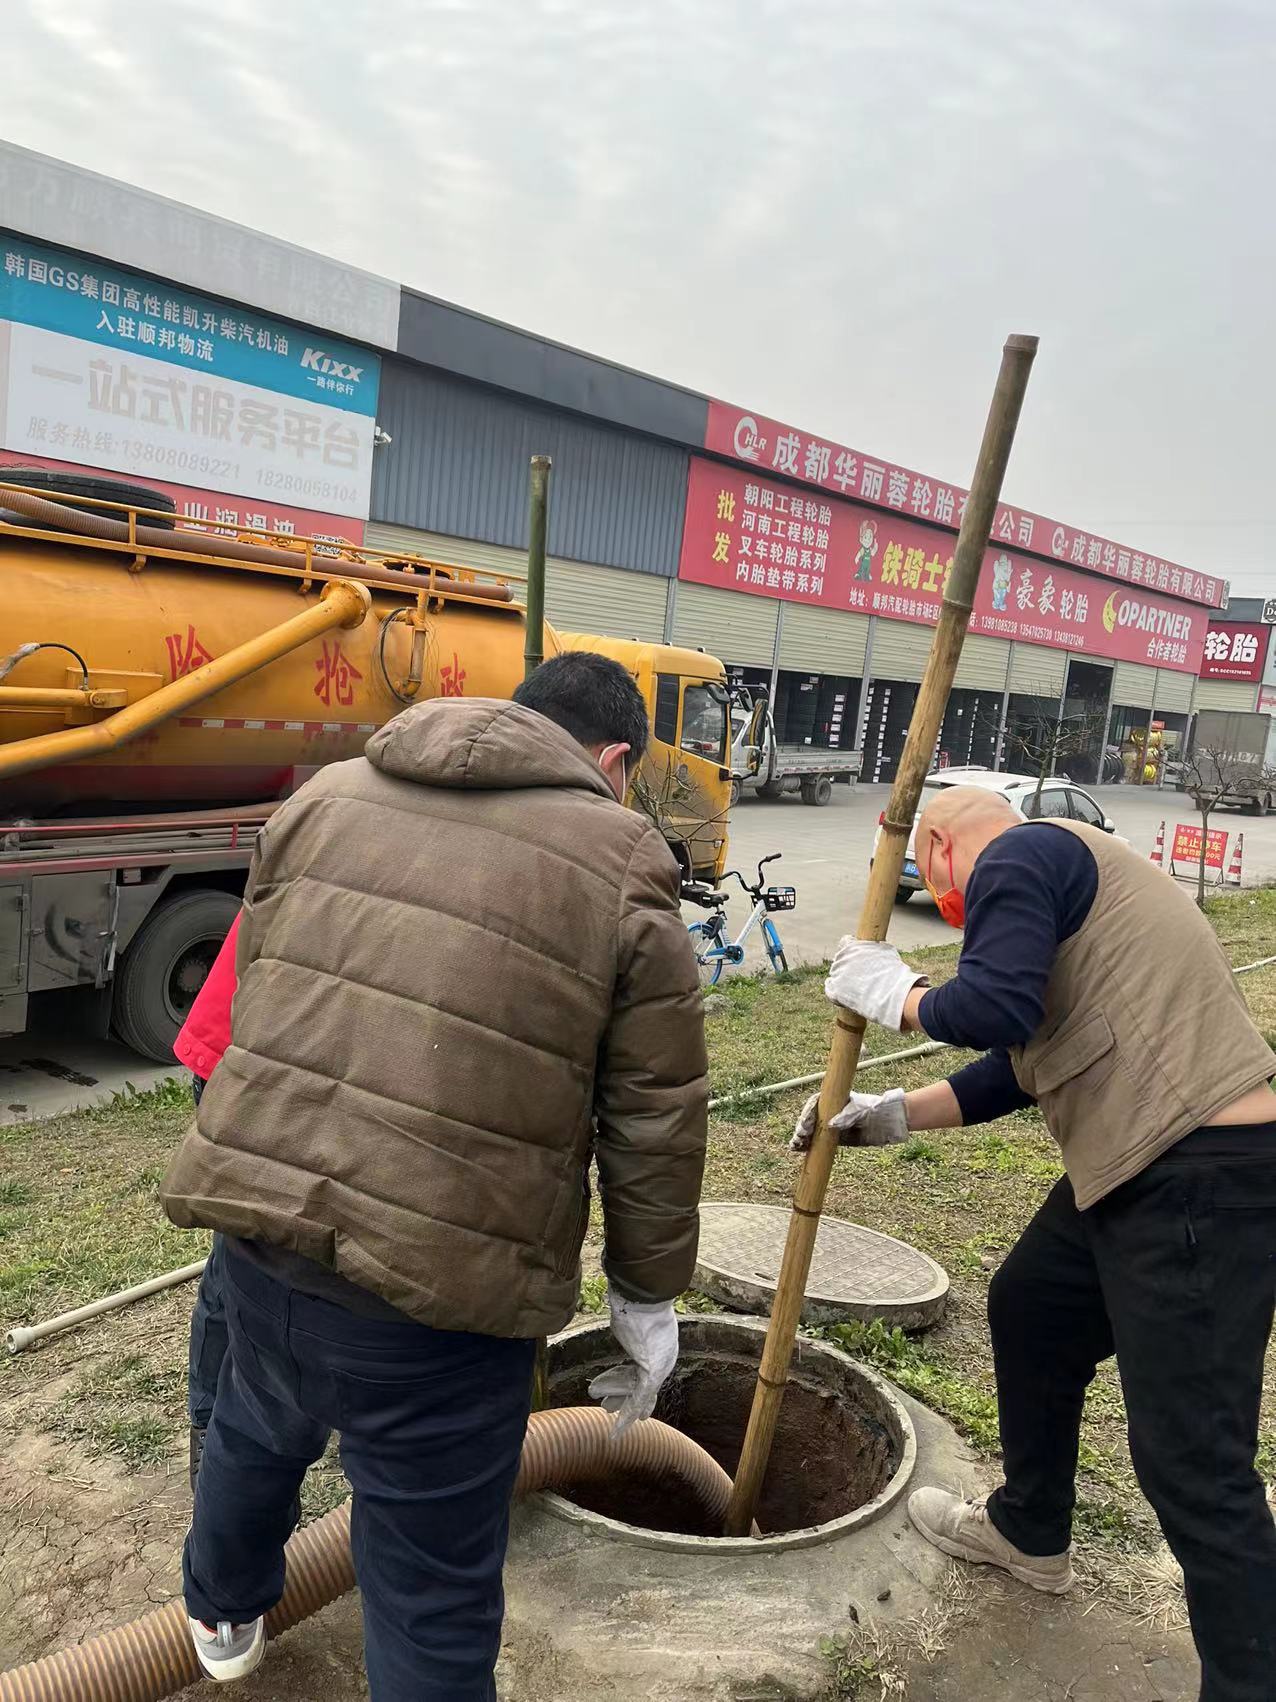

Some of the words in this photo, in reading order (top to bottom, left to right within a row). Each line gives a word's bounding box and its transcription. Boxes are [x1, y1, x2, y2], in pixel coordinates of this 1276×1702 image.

[4, 252, 289, 357] 韩国GS集团高性能凯升柴汽机油
[96, 309, 215, 363] 入驻顺邦物流
[306, 375, 355, 396] 一路伴你行
[31, 358, 360, 471] 一站式服务平台
[743, 483, 832, 527] 朝阳工程轮胎
[771, 432, 1035, 547] 成都华丽蓉轮胎公司
[712, 489, 736, 563] 批发
[741, 508, 830, 550] 河南工程轮胎
[738, 535, 827, 573] 叉车轮胎系列
[1070, 535, 1216, 603] 成都华丽蓉轮胎有限公司
[735, 560, 824, 596] 内胎垫带系列
[1146, 637, 1188, 665] 合作者轮胎
[1204, 631, 1259, 663] 轮胎
